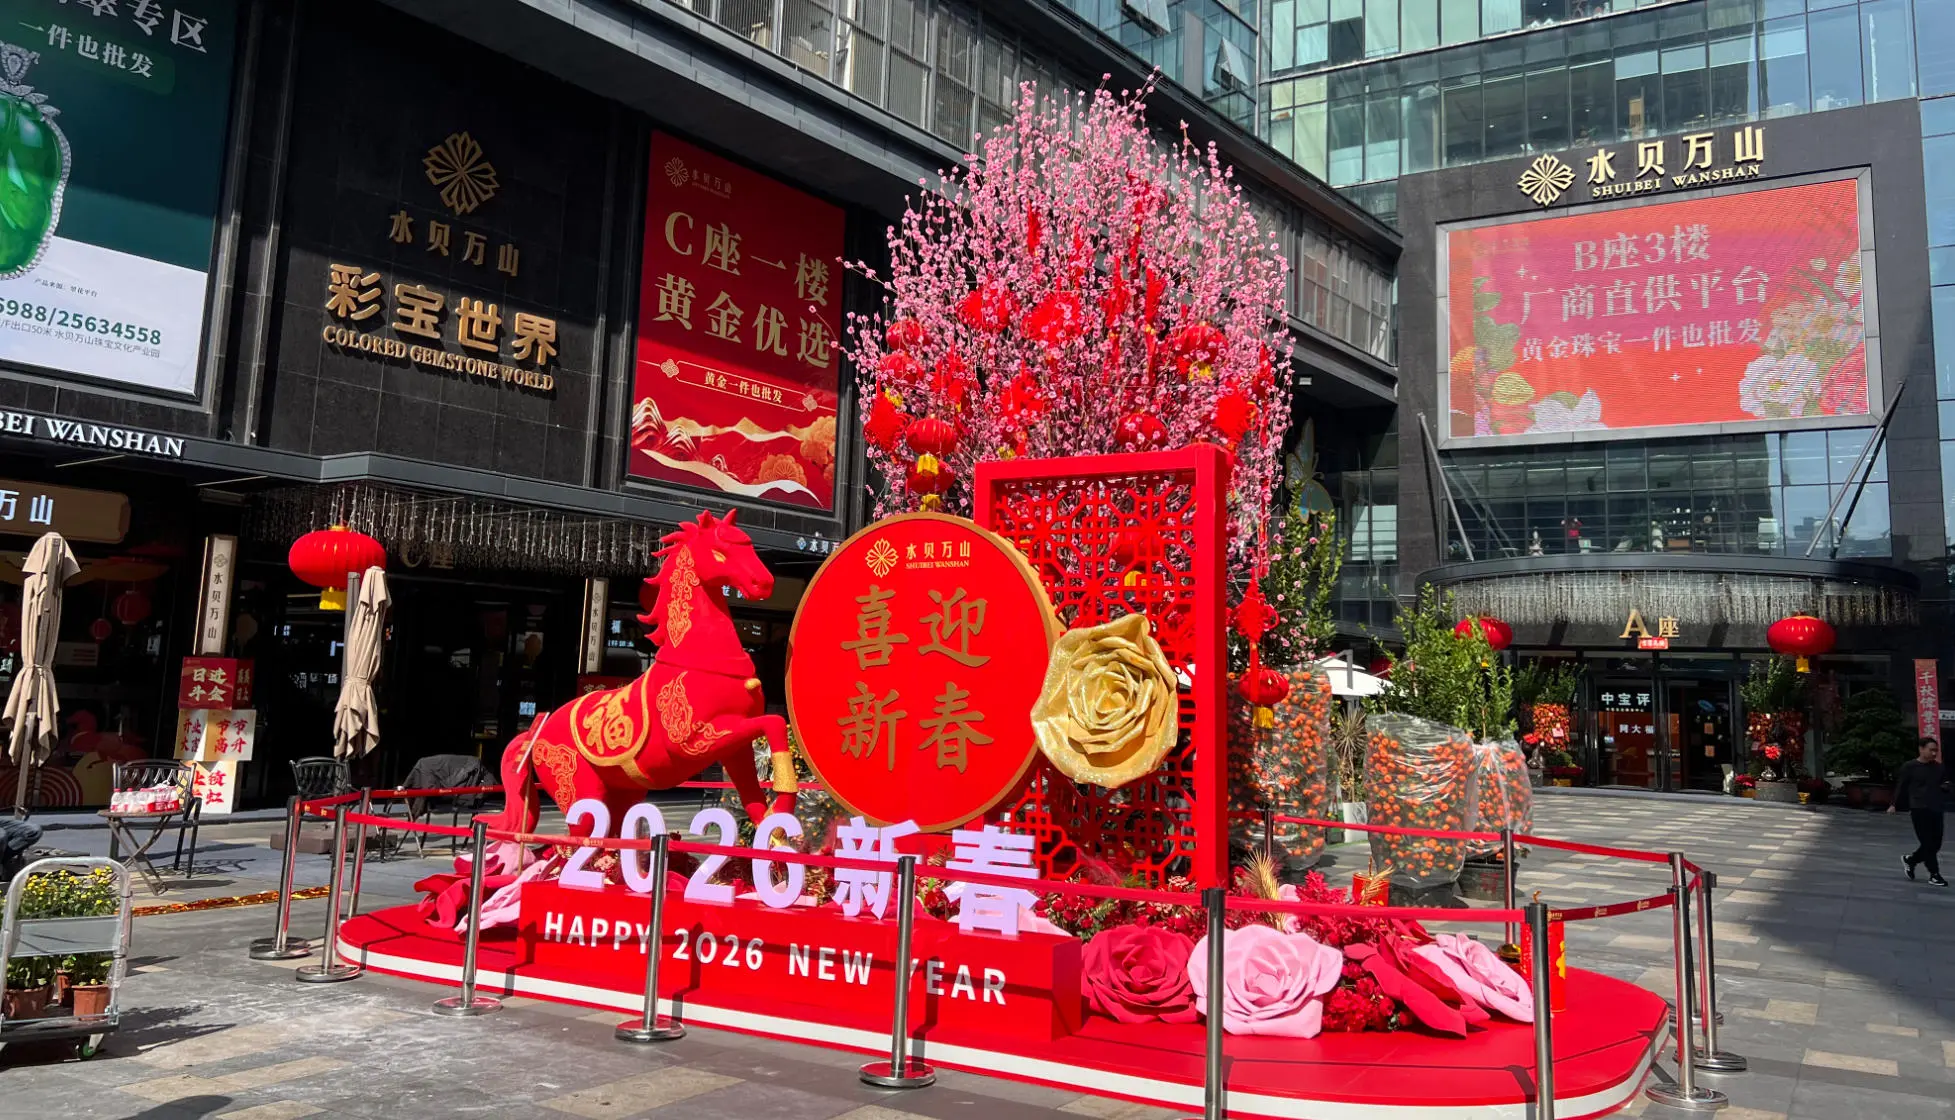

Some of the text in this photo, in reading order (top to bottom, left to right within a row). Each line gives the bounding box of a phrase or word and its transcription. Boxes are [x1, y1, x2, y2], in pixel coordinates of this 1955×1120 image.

[18, 21, 154, 78] 一件也批发
[58, 0, 209, 53] 专区
[1587, 126, 1764, 184] 水贝万山
[1592, 164, 1761, 197] SHUIBEI WANSHAN
[388, 210, 520, 277] 水贝万山
[664, 211, 829, 306] C座一楼
[1572, 223, 1711, 272] B座3楼
[324, 262, 558, 366] 彩宝世界
[652, 272, 831, 369] 黄金优选
[1520, 265, 1770, 325] 厂商直供平台
[322, 325, 555, 391] COLORED GEMSTONE WORLD
[1520, 317, 1763, 364] 黄金珠宝一件也批发
[704, 371, 783, 404] 黄金一件也批发
[0, 411, 185, 458] EI WANSHAN
[0, 489, 54, 526] 万山
[906, 540, 970, 560] 水贝万山
[207, 572, 224, 640] 水贝万山
[841, 584, 992, 670] 喜迎
[1619, 609, 1680, 639] A座
[216, 719, 248, 736] 节节
[582, 683, 634, 755] 福
[1601, 692, 1651, 706] 中宝评
[214, 737, 247, 754] 高升
[837, 681, 995, 775] 新春
[544, 911, 651, 955] HAPPY
[672, 927, 764, 971] 2026
[788, 942, 874, 986] NEW
